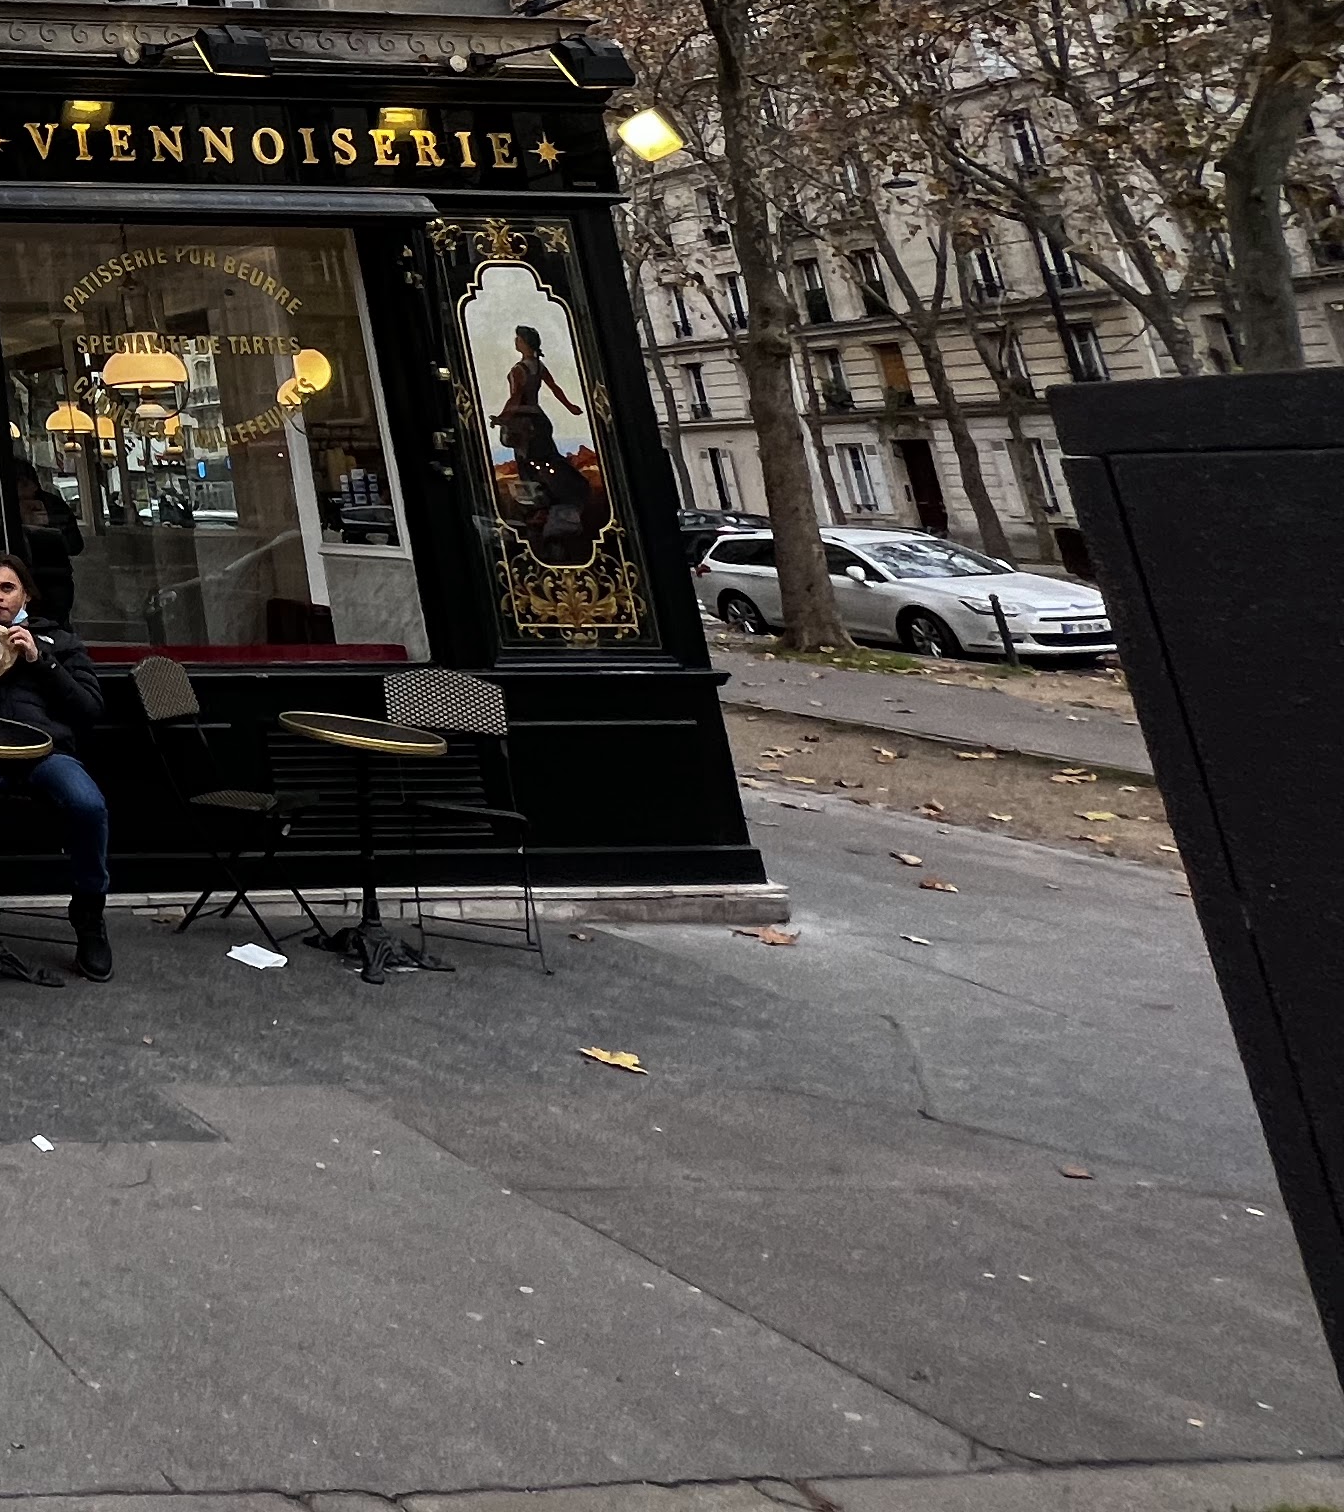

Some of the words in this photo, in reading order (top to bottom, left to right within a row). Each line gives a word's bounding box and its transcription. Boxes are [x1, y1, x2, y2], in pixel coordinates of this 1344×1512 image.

[23, 121, 518, 169] VIENNOISERIE
[175, 246, 216, 268] PUR
[223, 255, 303, 316] BEURRE
[196, 335, 221, 356] DE
[227, 335, 302, 356] TARTES
